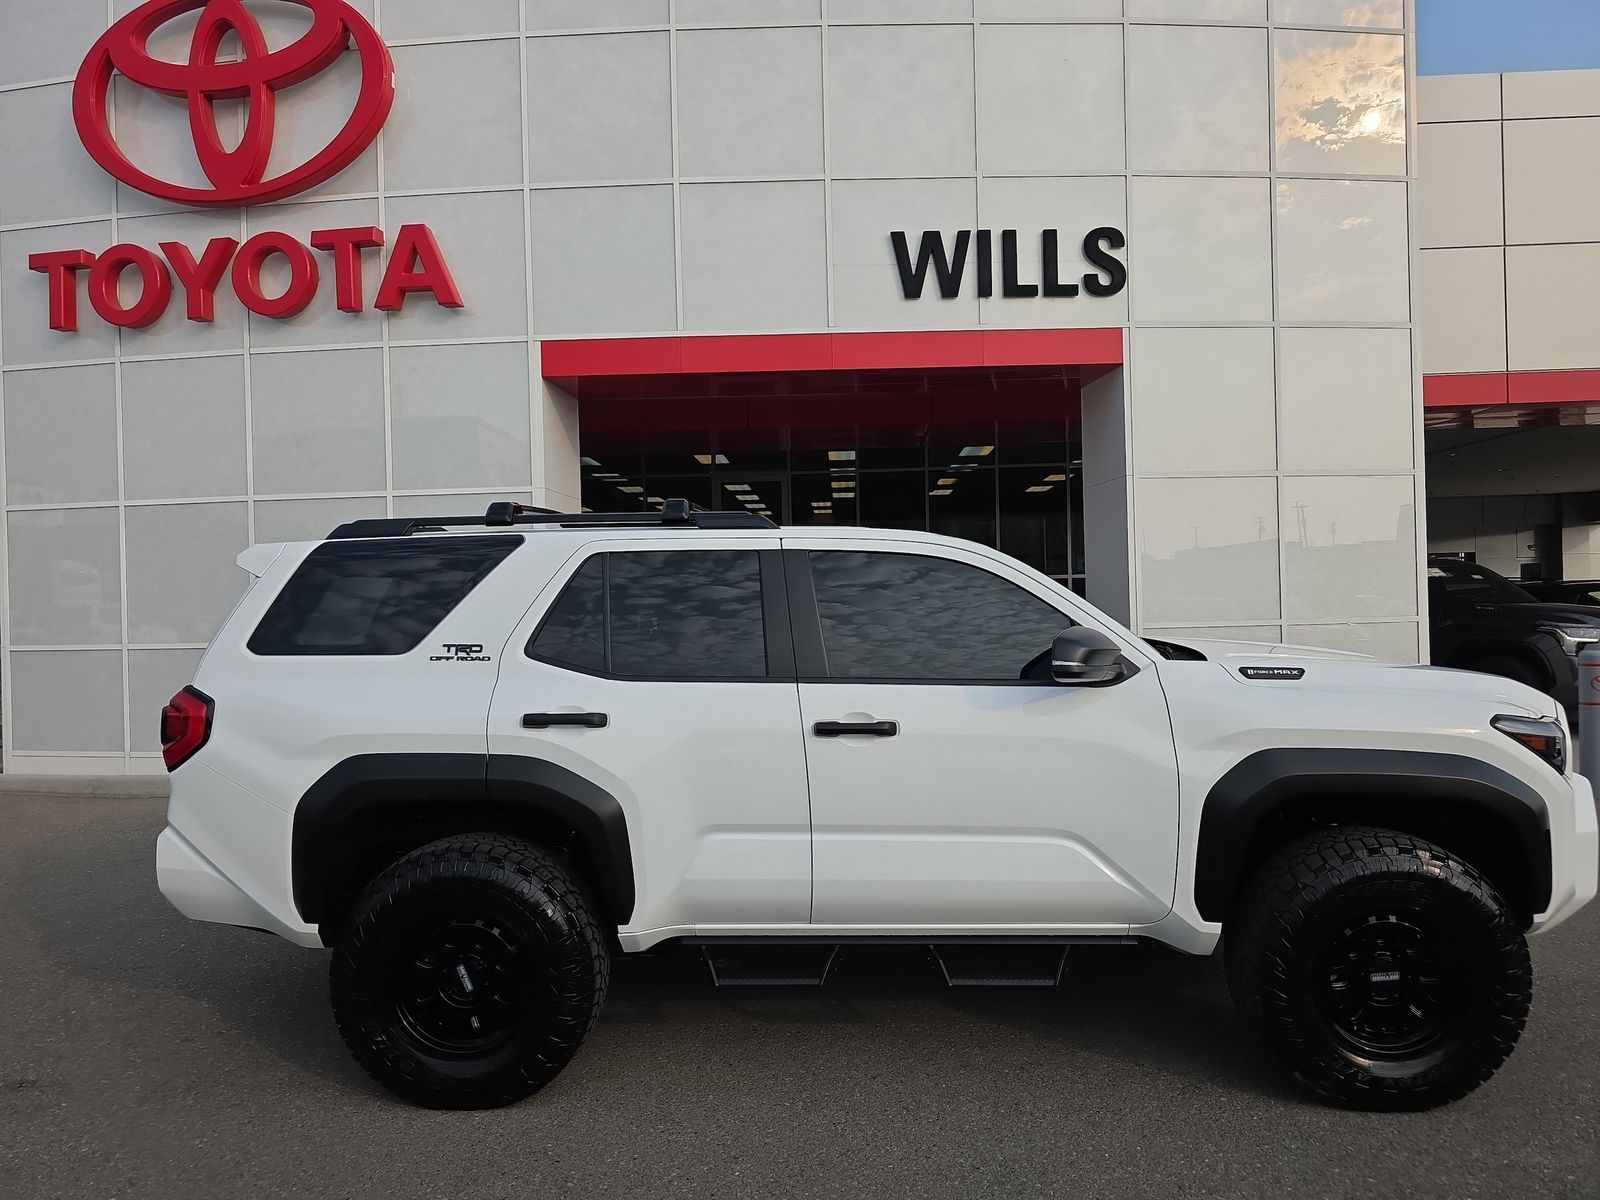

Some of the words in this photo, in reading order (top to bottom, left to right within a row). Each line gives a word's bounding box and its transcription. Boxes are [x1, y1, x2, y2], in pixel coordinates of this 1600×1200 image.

[28, 223, 465, 332] TOYOTA
[890, 226, 1127, 299] WILLS
[442, 643, 484, 656] TRD
